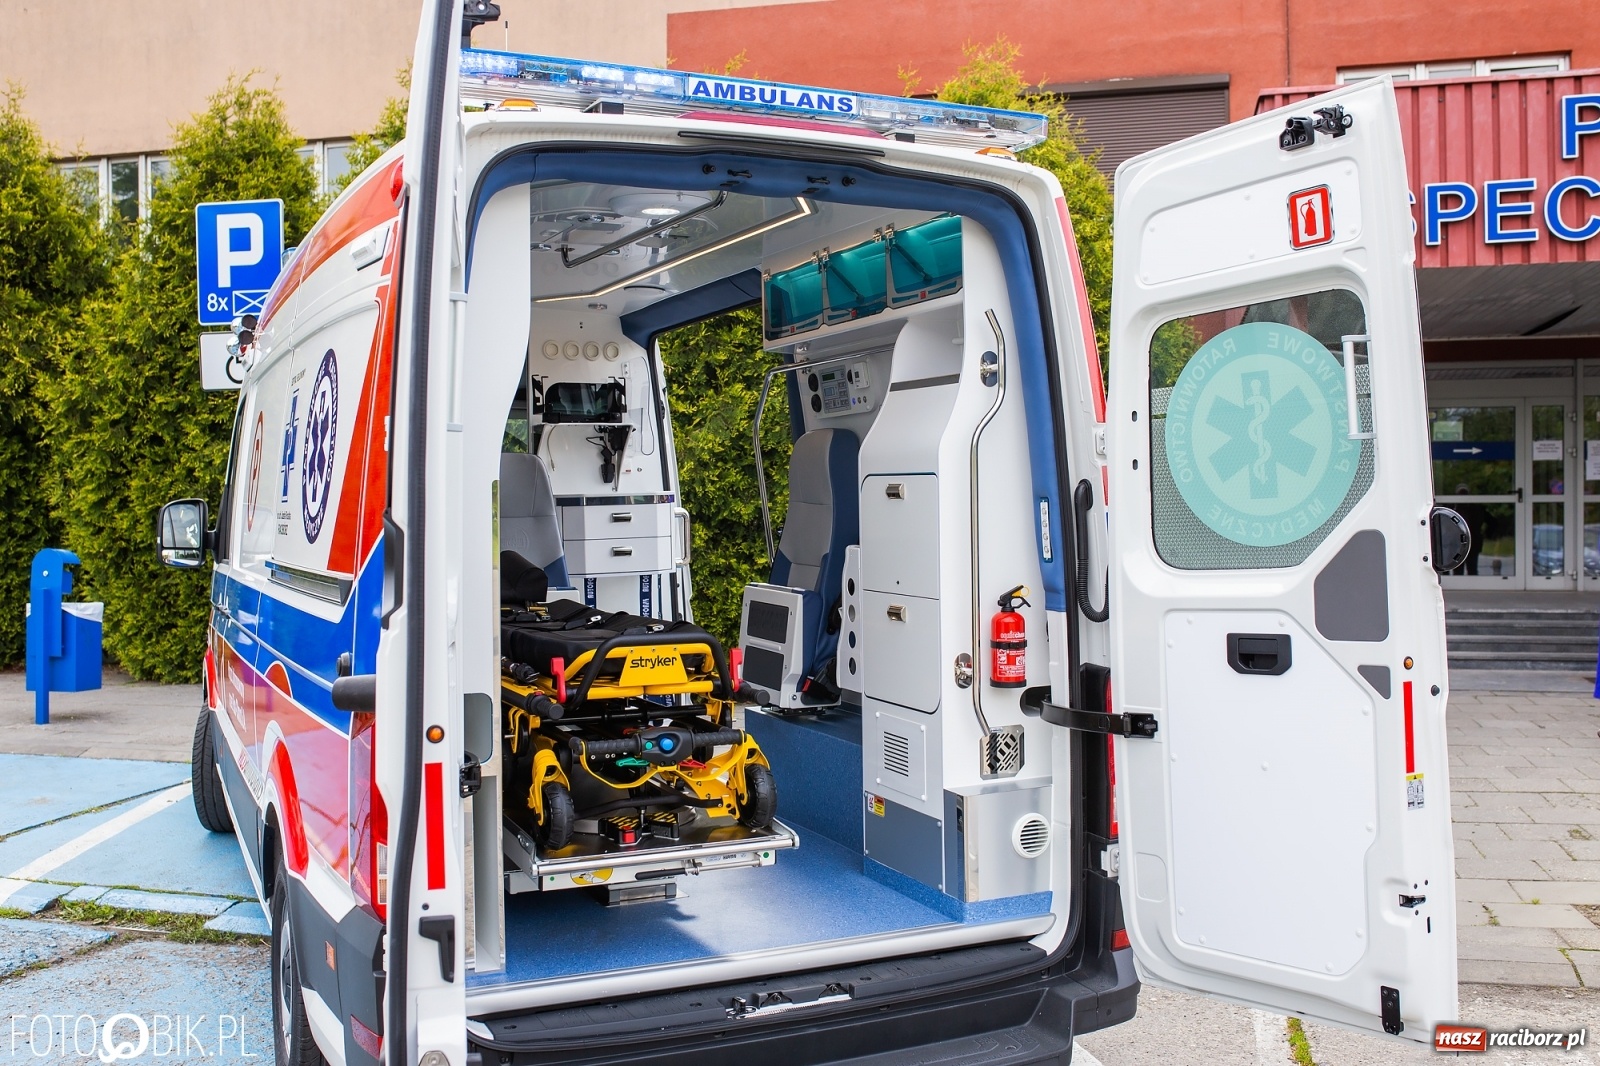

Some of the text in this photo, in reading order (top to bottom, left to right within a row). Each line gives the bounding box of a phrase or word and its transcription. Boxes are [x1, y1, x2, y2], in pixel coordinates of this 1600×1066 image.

[692, 80, 854, 113] AMBULANS
[1562, 94, 1600, 159] P
[1409, 175, 1600, 246] PEC
[216, 212, 264, 288] P
[207, 293, 229, 312] 8x
[629, 655, 677, 670] stryker
